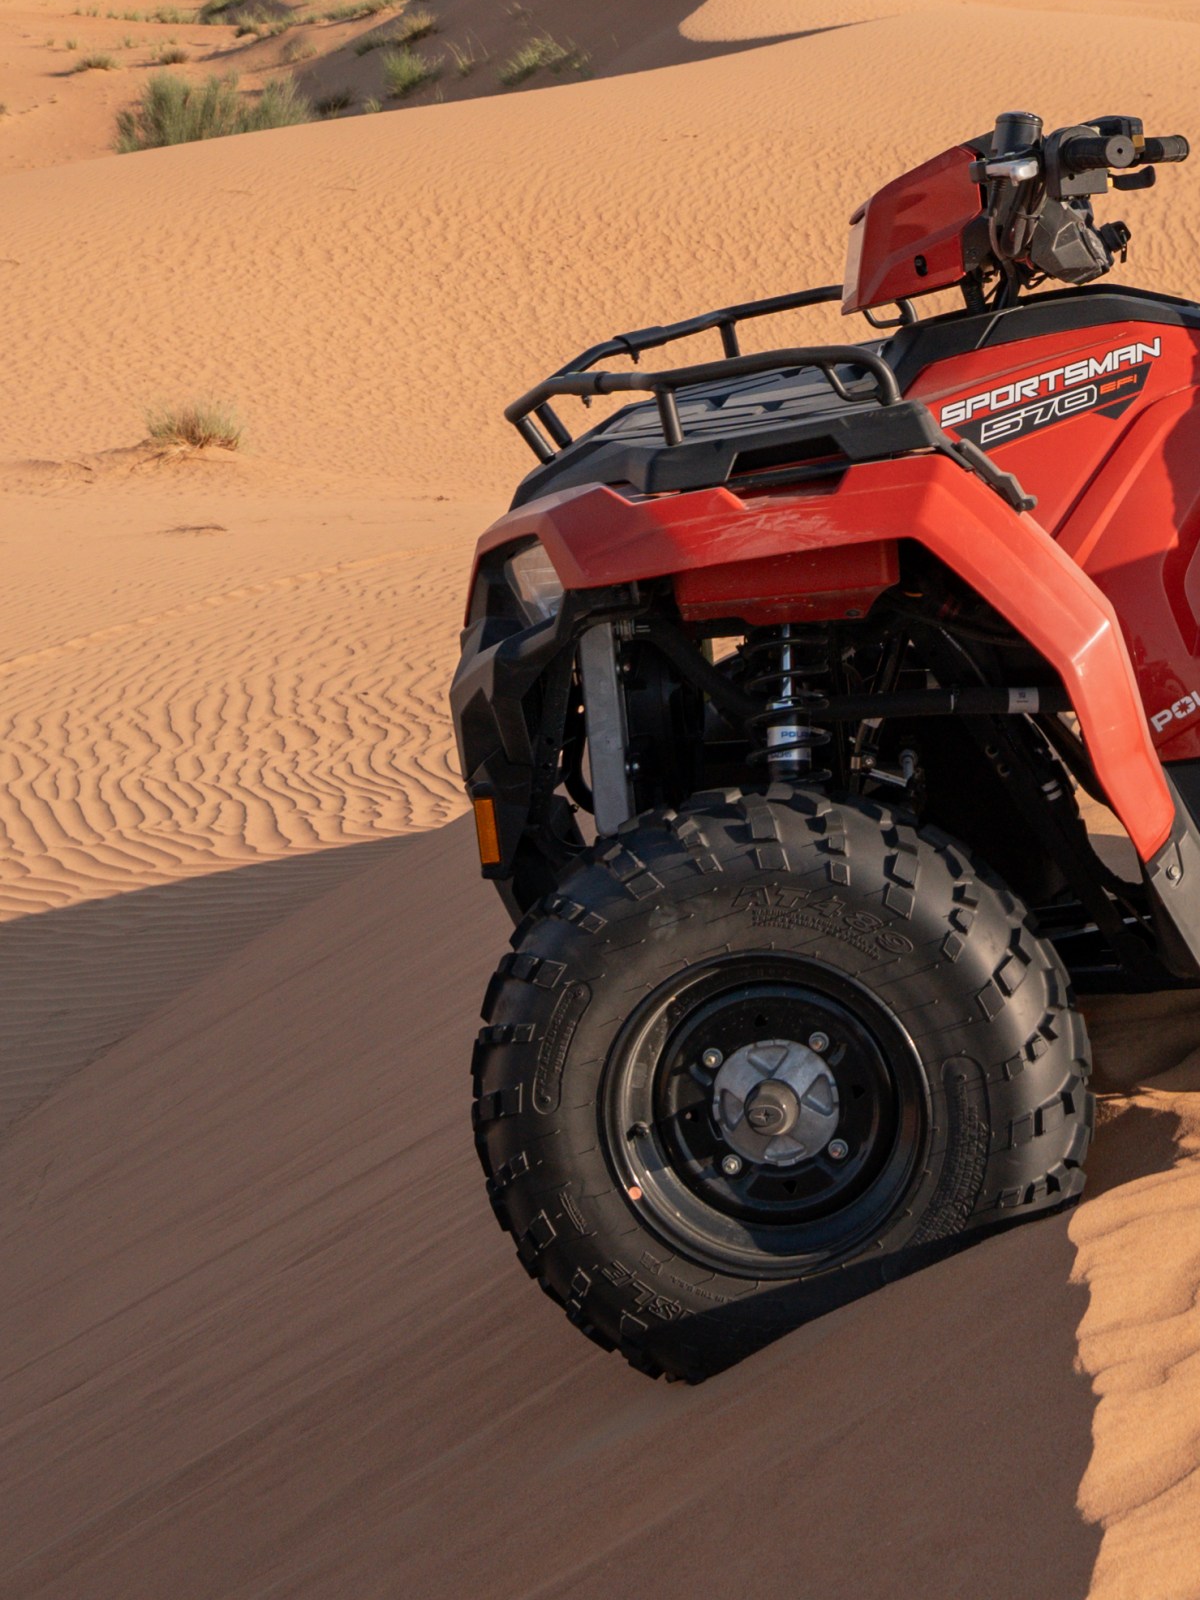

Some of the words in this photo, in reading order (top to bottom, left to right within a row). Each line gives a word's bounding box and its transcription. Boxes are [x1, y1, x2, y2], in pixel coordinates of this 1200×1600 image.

[940, 337, 1161, 429] SPORTSMAN
[980, 384, 1098, 445] 570
[1100, 374, 1138, 395] EFI
[731, 886, 914, 954] AT489
